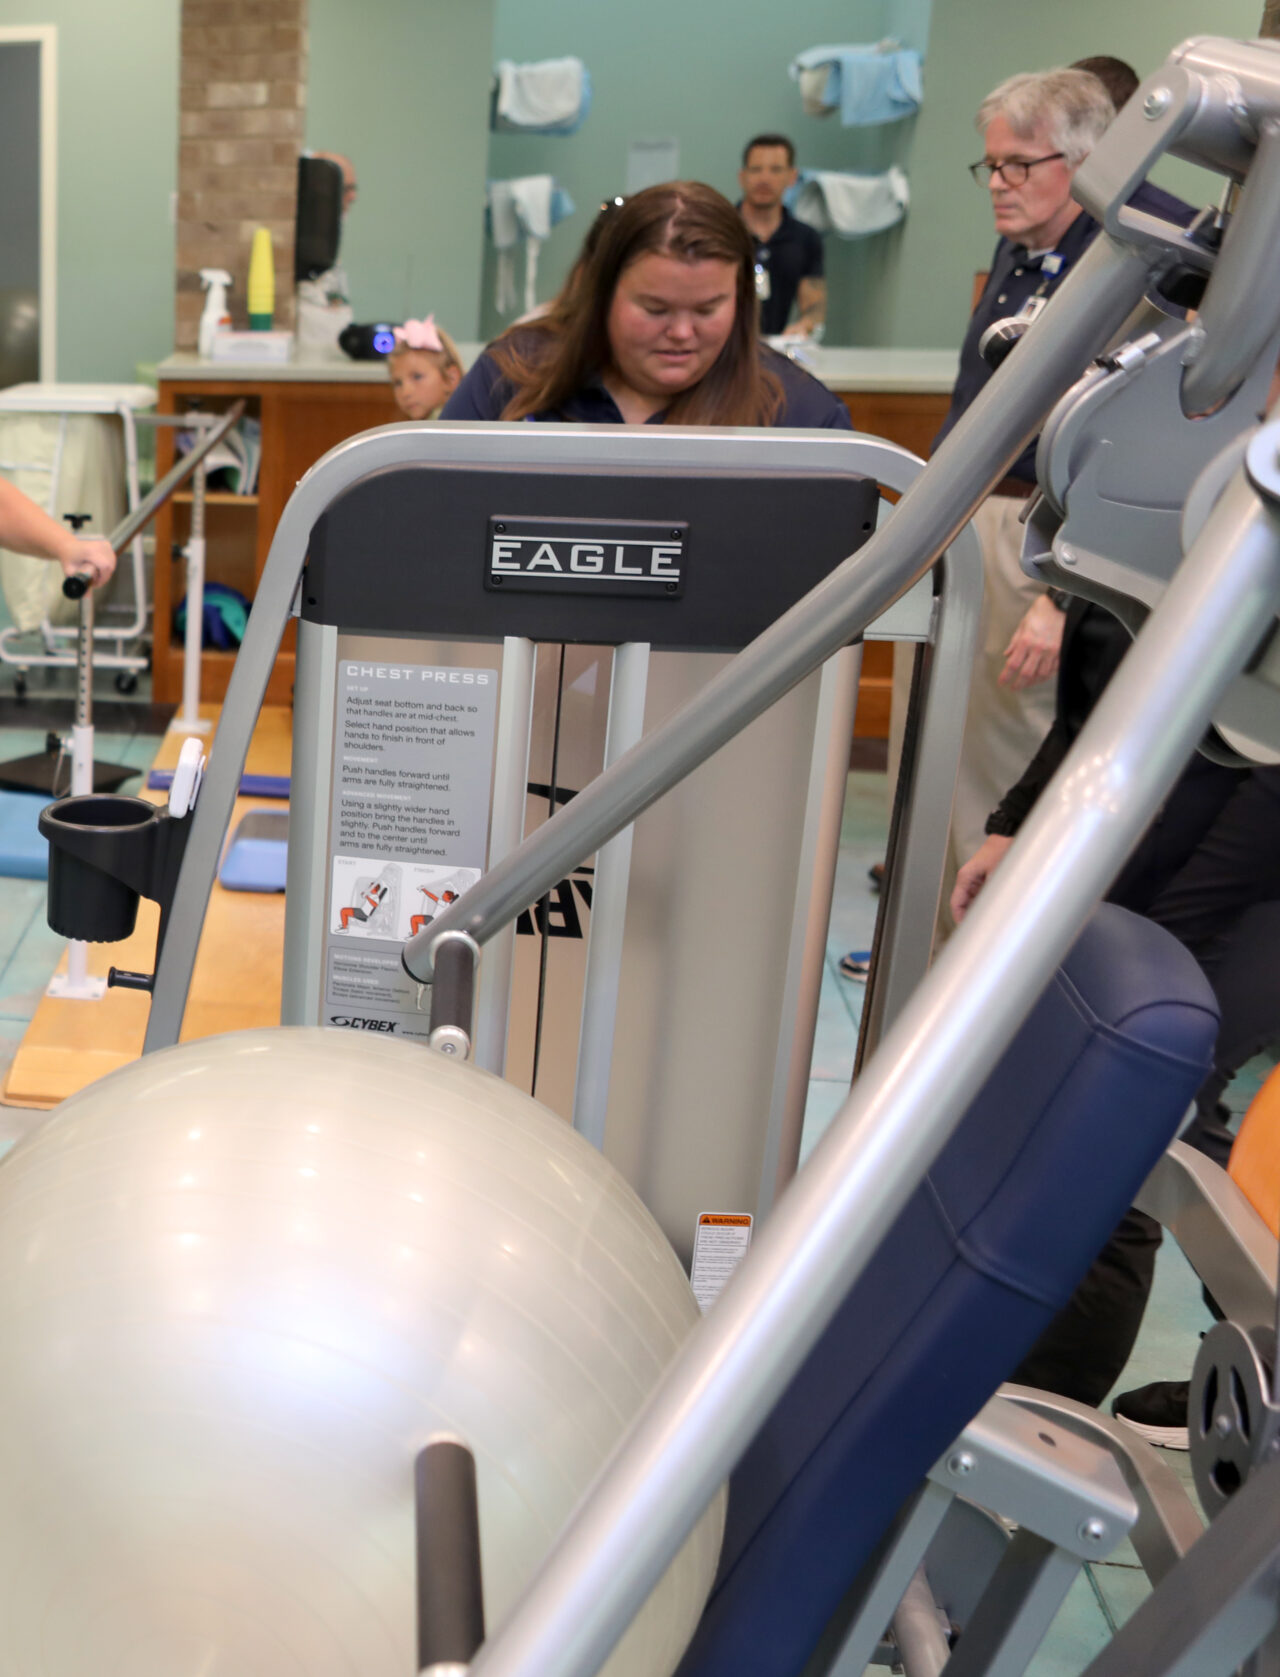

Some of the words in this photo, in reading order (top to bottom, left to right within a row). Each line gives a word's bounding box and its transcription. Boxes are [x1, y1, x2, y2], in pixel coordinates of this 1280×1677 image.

[492, 541, 682, 576] EAGLE
[347, 666, 413, 680] CHEST
[422, 671, 489, 684] PRESS
[347, 696, 372, 707] Adjust
[375, 699, 392, 707] seat
[394, 700, 424, 709] bottom
[426, 702, 442, 710] and
[444, 703, 464, 712] back
[363, 709, 393, 717] handles
[418, 713, 457, 722] mid-chest.
[345, 720, 370, 729] Select
[372, 722, 392, 731] hand
[395, 724, 428, 734] position
[430, 727, 446, 735] that
[449, 728, 475, 737] allows
[344, 731, 369, 740] hands
[382, 734, 403, 742] finish
[406, 735, 413, 743] in
[415, 736, 434, 745] front
[344, 741, 384, 750] shoulders.
[343, 765, 363, 774] Push
[365, 767, 396, 777] handles
[399, 770, 430, 780] forward
[432, 773, 450, 781] until
[379, 779, 395, 788] fully
[398, 781, 451, 791] straightened.
[342, 800, 366, 809] Using
[374, 802, 402, 812] slightly
[429, 807, 450, 815] hand
[341, 810, 373, 819] position
[375, 812, 395, 822] bring
[398, 815, 411, 823] the
[413, 816, 445, 825] handles
[341, 820, 369, 830] slightly.
[373, 822, 392, 831] Push
[395, 824, 426, 834] handles
[429, 827, 460, 837] forward
[340, 830, 355, 838] and
[410, 836, 428, 844] until
[376, 842, 392, 852] fully
[395, 845, 448, 856] straightened.
[351, 1018, 396, 1033] CYBEX
